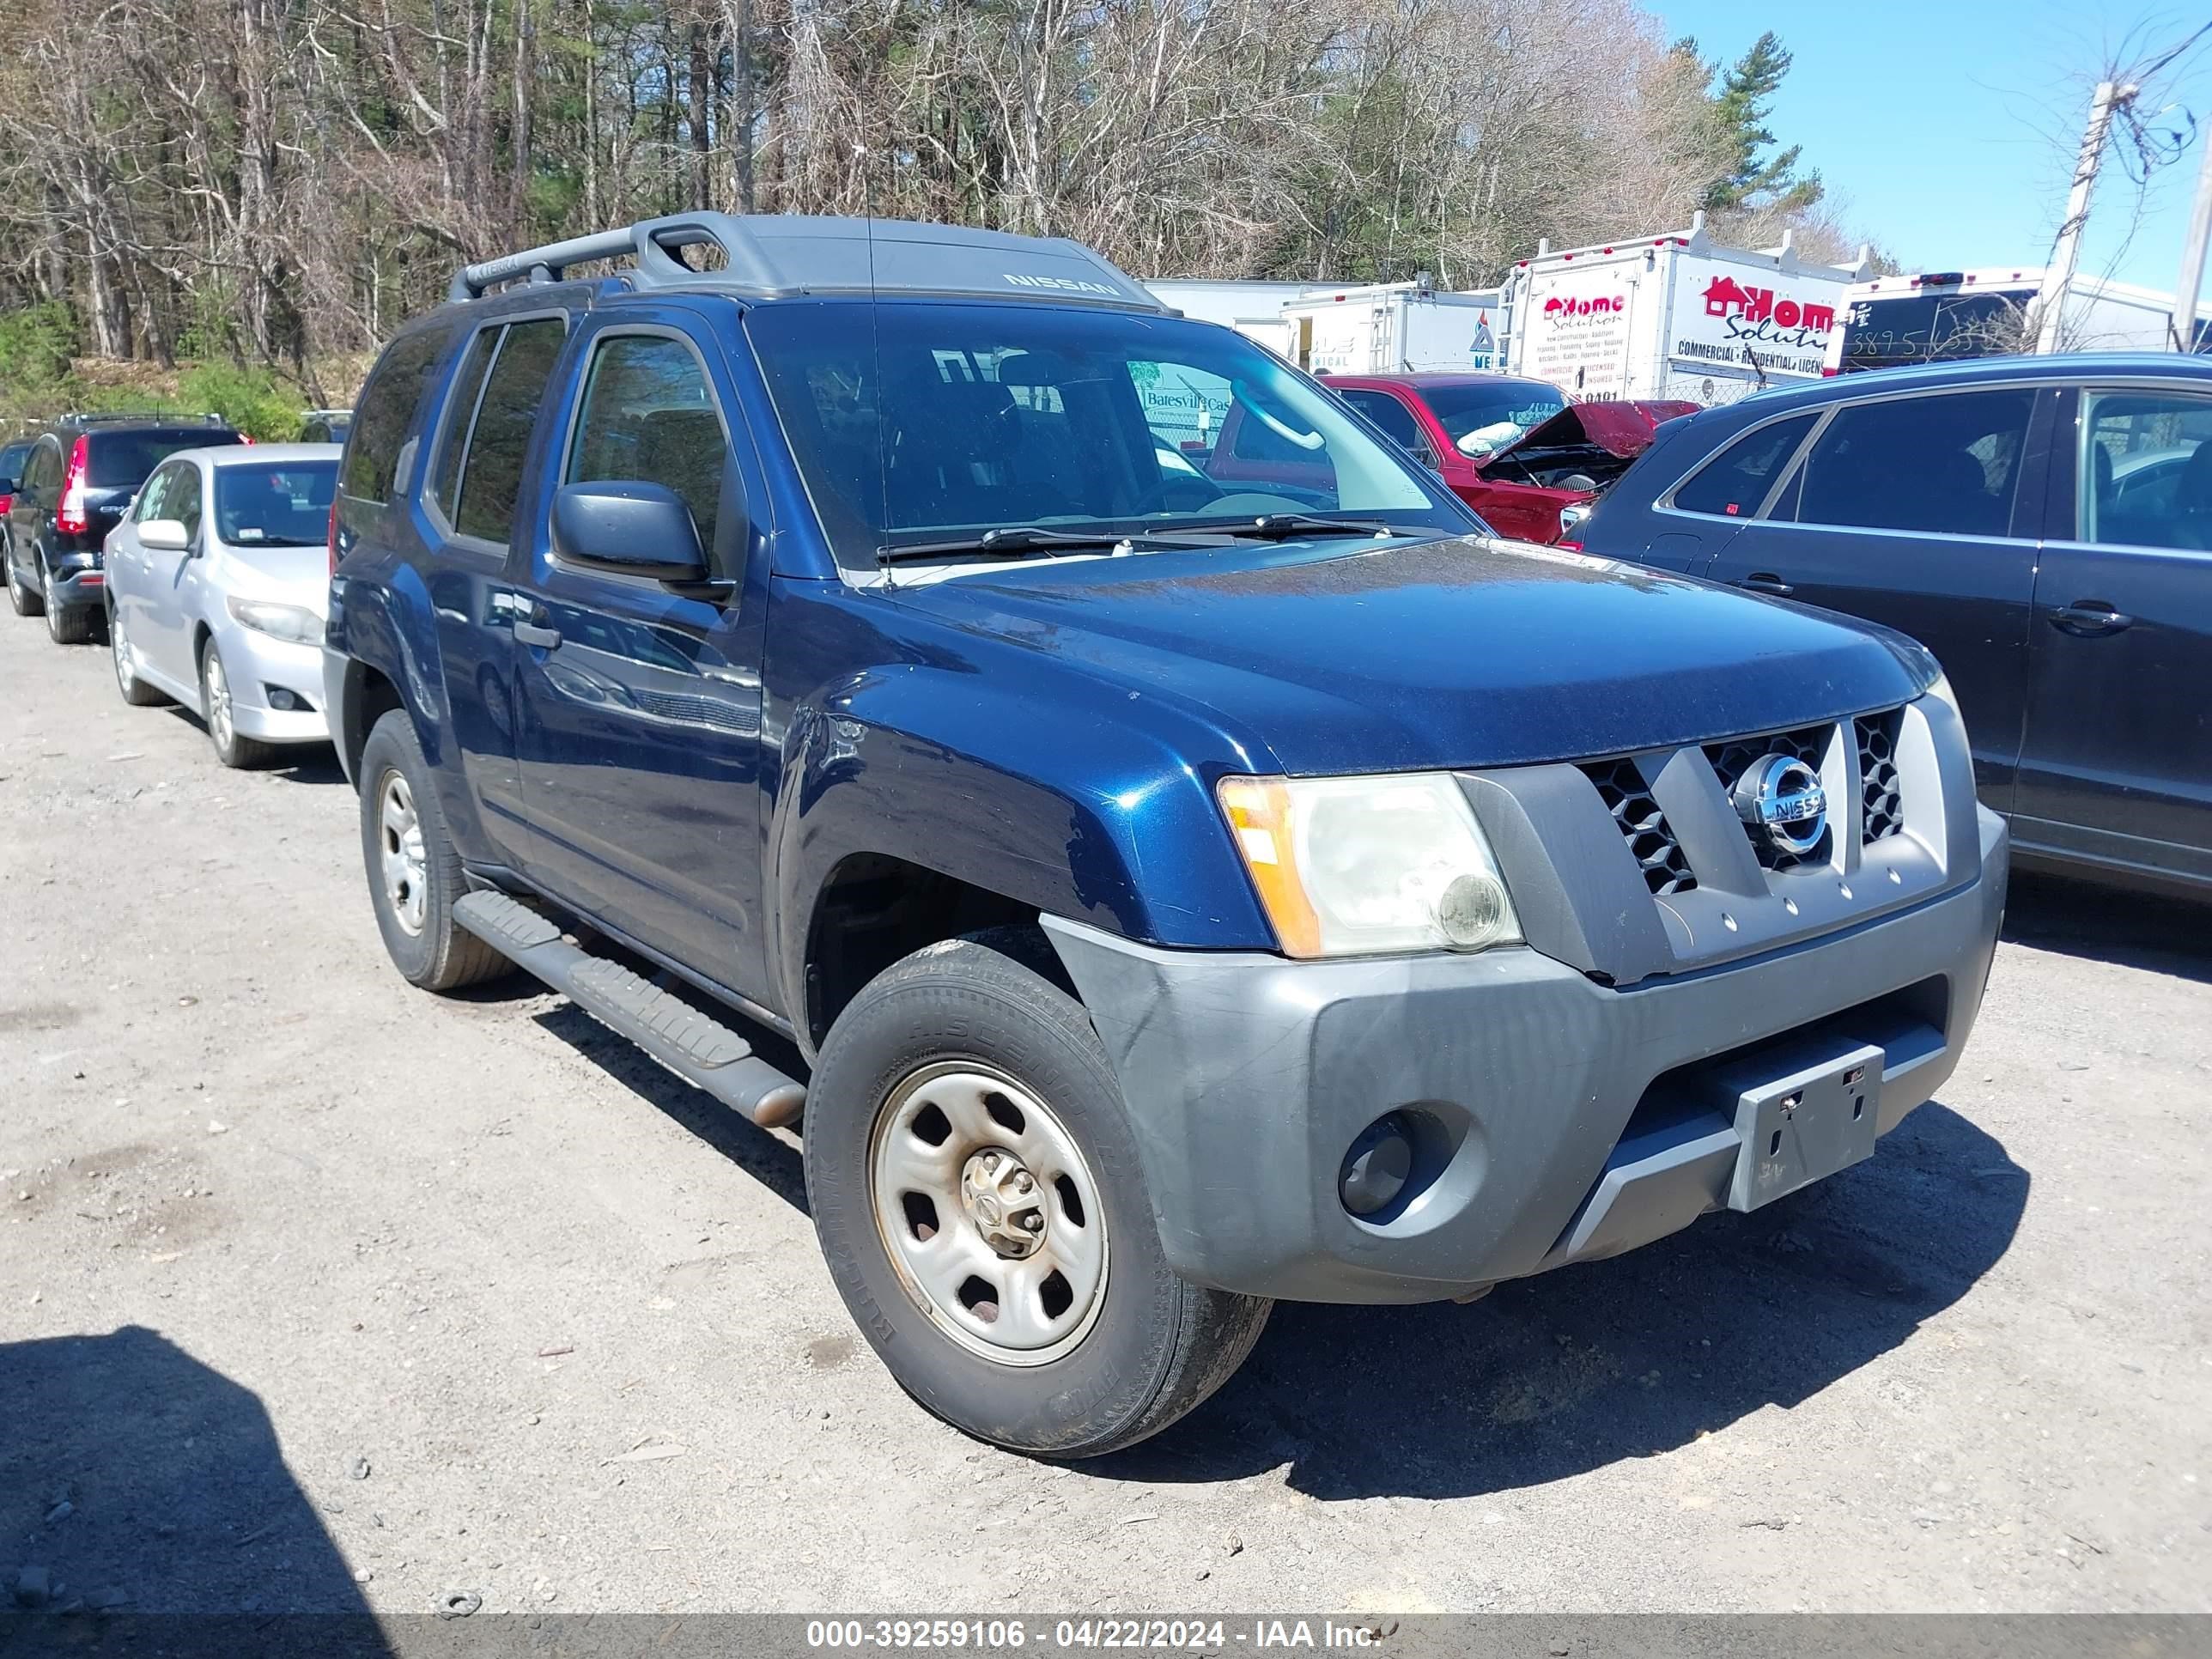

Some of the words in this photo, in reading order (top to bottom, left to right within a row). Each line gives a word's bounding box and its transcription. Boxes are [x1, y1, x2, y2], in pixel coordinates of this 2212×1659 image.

[1002, 274, 1121, 296] NISSAN
[1678, 340, 1735, 362] COMMERCIAL
[1148, 392, 1206, 409] Batesvill
